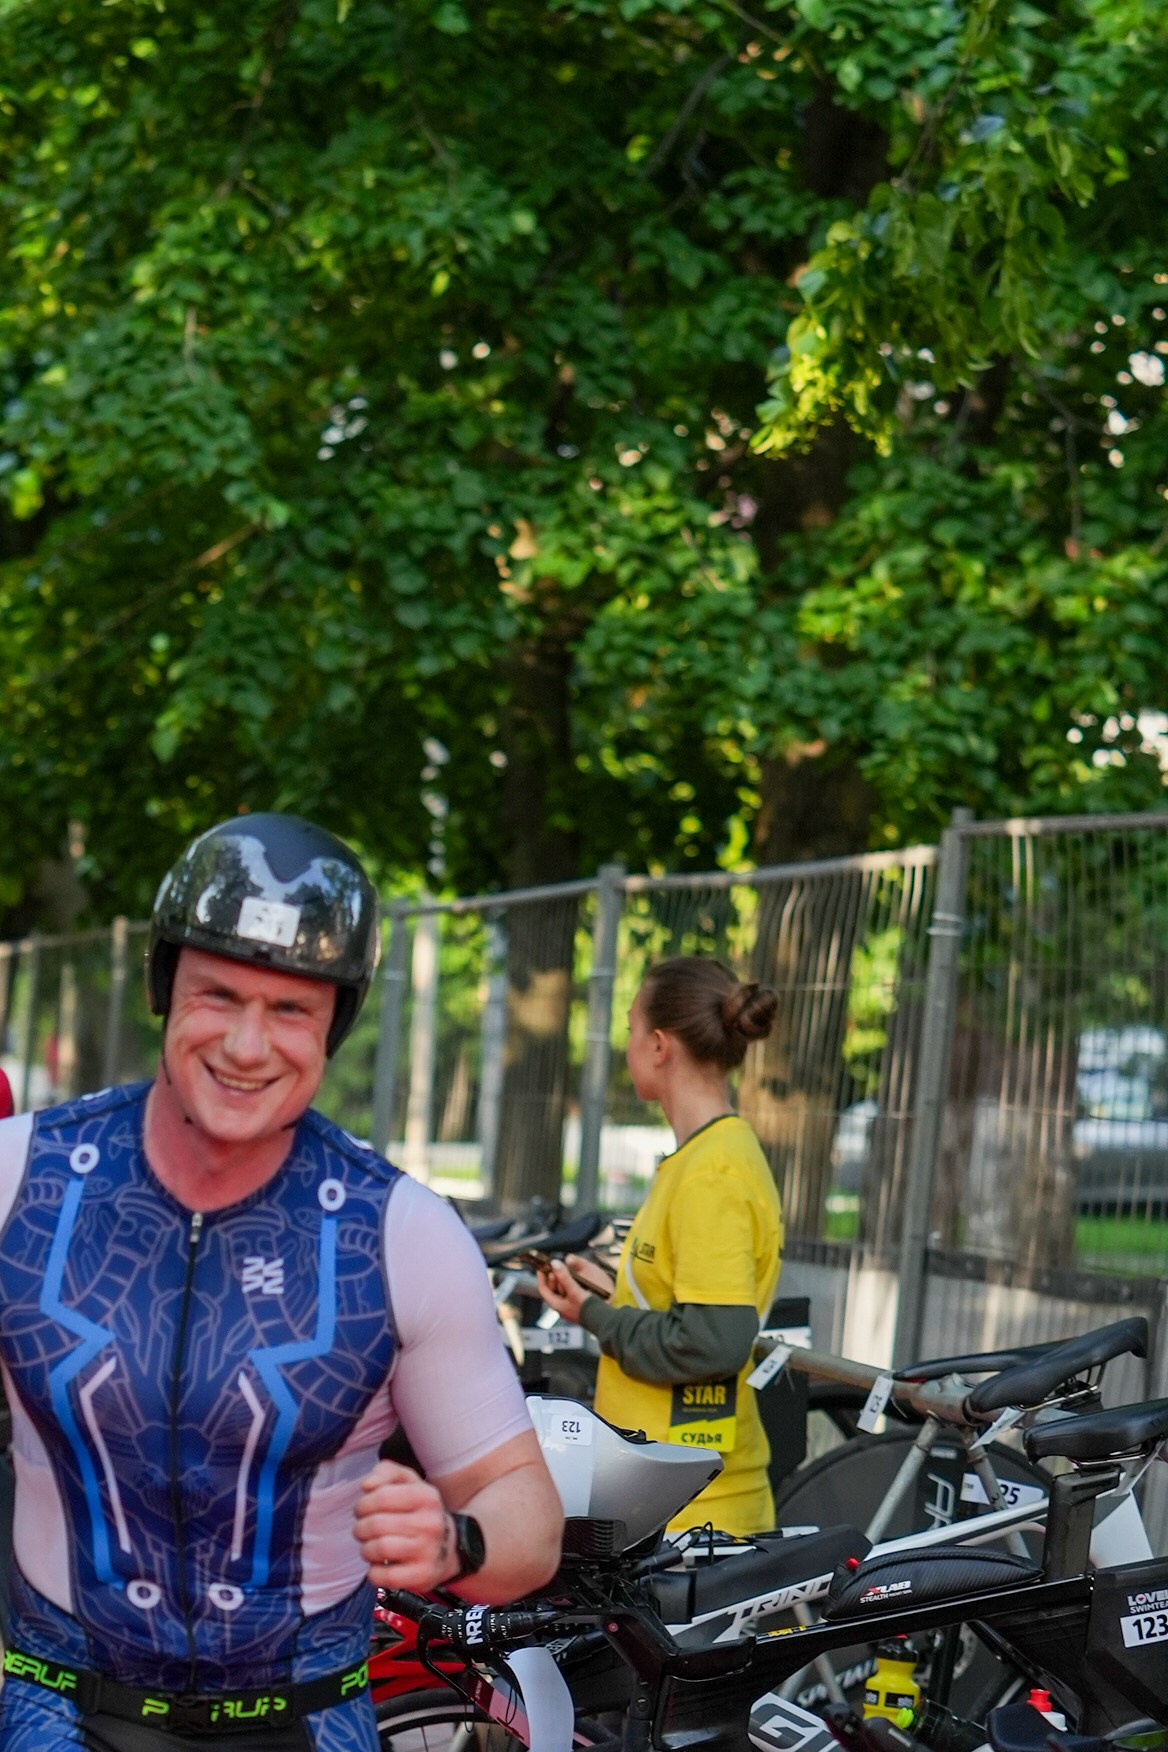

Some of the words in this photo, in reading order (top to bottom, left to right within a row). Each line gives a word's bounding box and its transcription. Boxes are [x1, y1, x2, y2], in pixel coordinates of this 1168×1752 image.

[682, 1385, 727, 1405] STAR
[561, 1420, 582, 1434] 123
[681, 1432, 722, 1445] СУДЬЯ
[999, 1484, 1020, 1505] 25
[1132, 1614, 1168, 1640] 123
